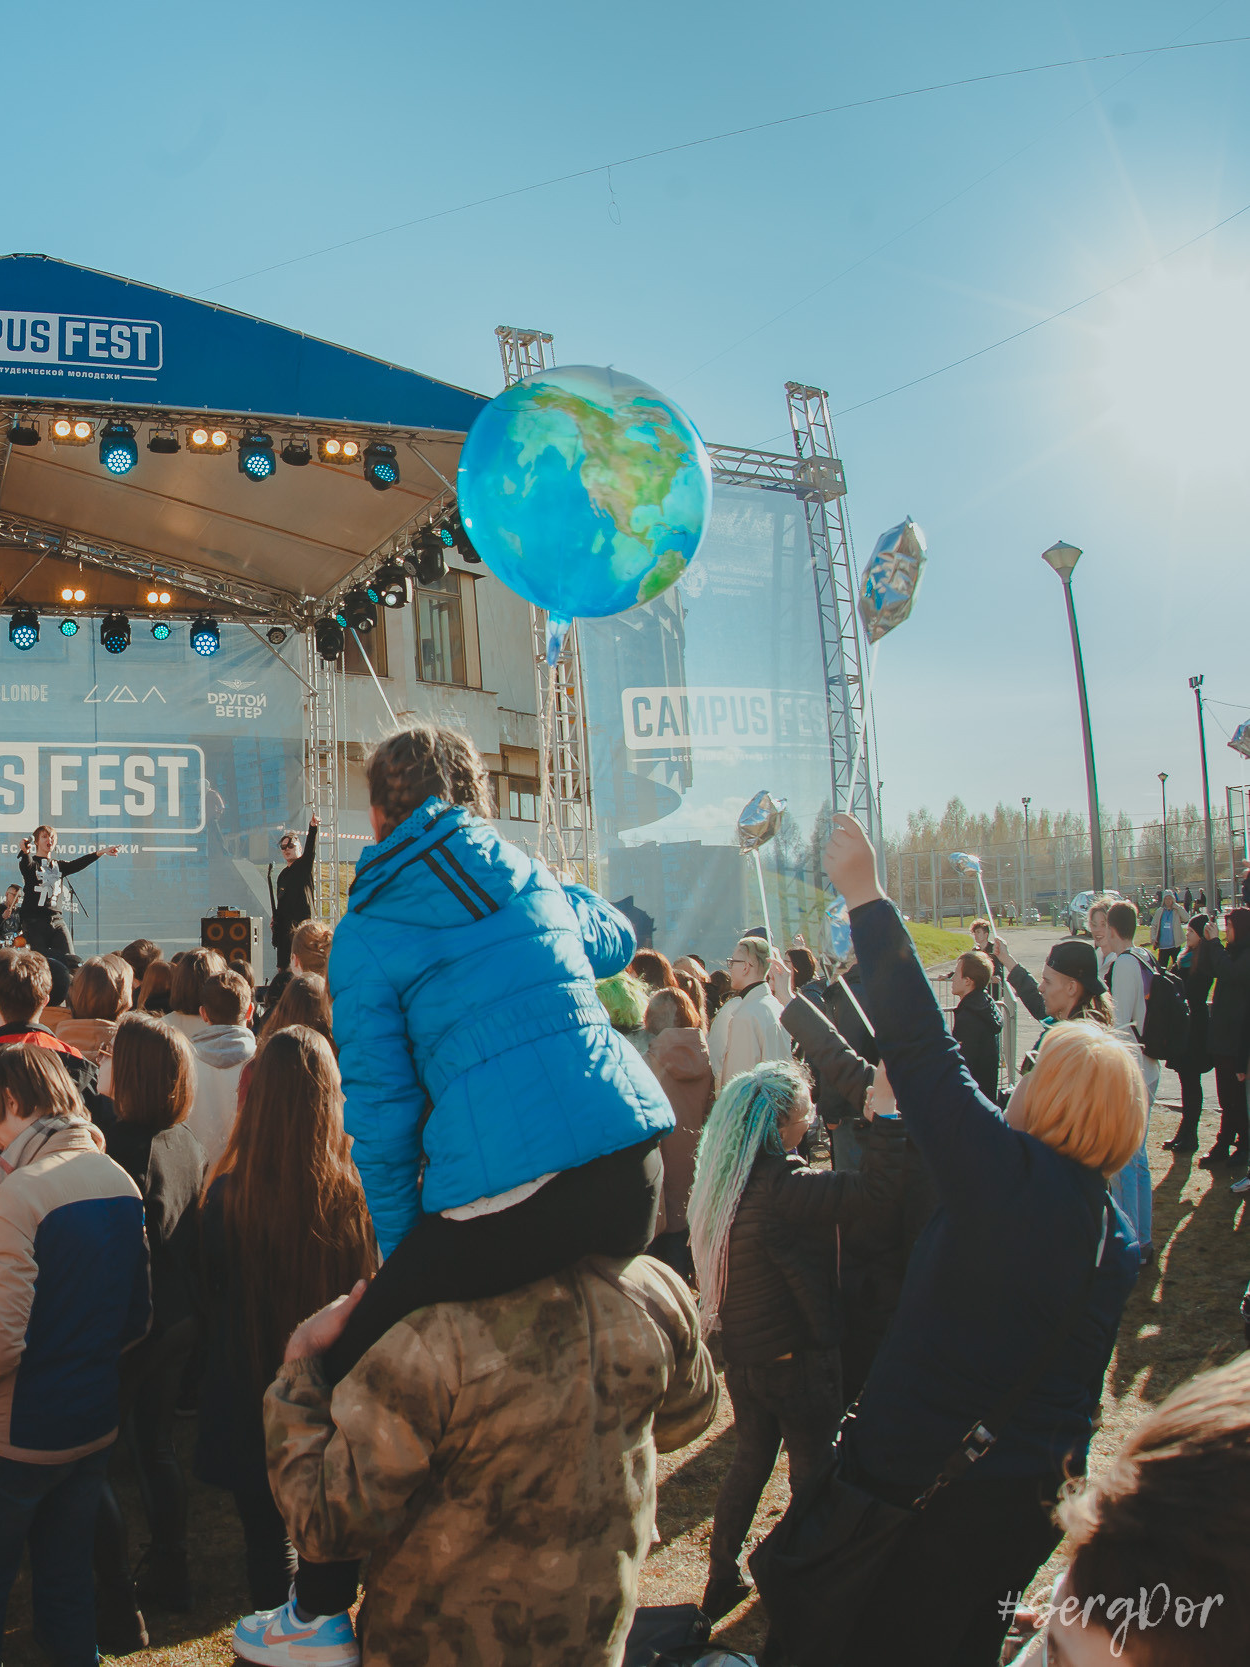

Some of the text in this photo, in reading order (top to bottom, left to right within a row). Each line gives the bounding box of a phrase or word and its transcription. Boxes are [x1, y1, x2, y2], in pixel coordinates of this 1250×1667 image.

[65, 320, 152, 361] FEST
[67, 371, 121, 380] МОЛОДЕЖИ
[215, 705, 262, 719] ВЕТЕР
[631, 695, 829, 738] CAMPUS FES
[50, 755, 188, 817] FEST
